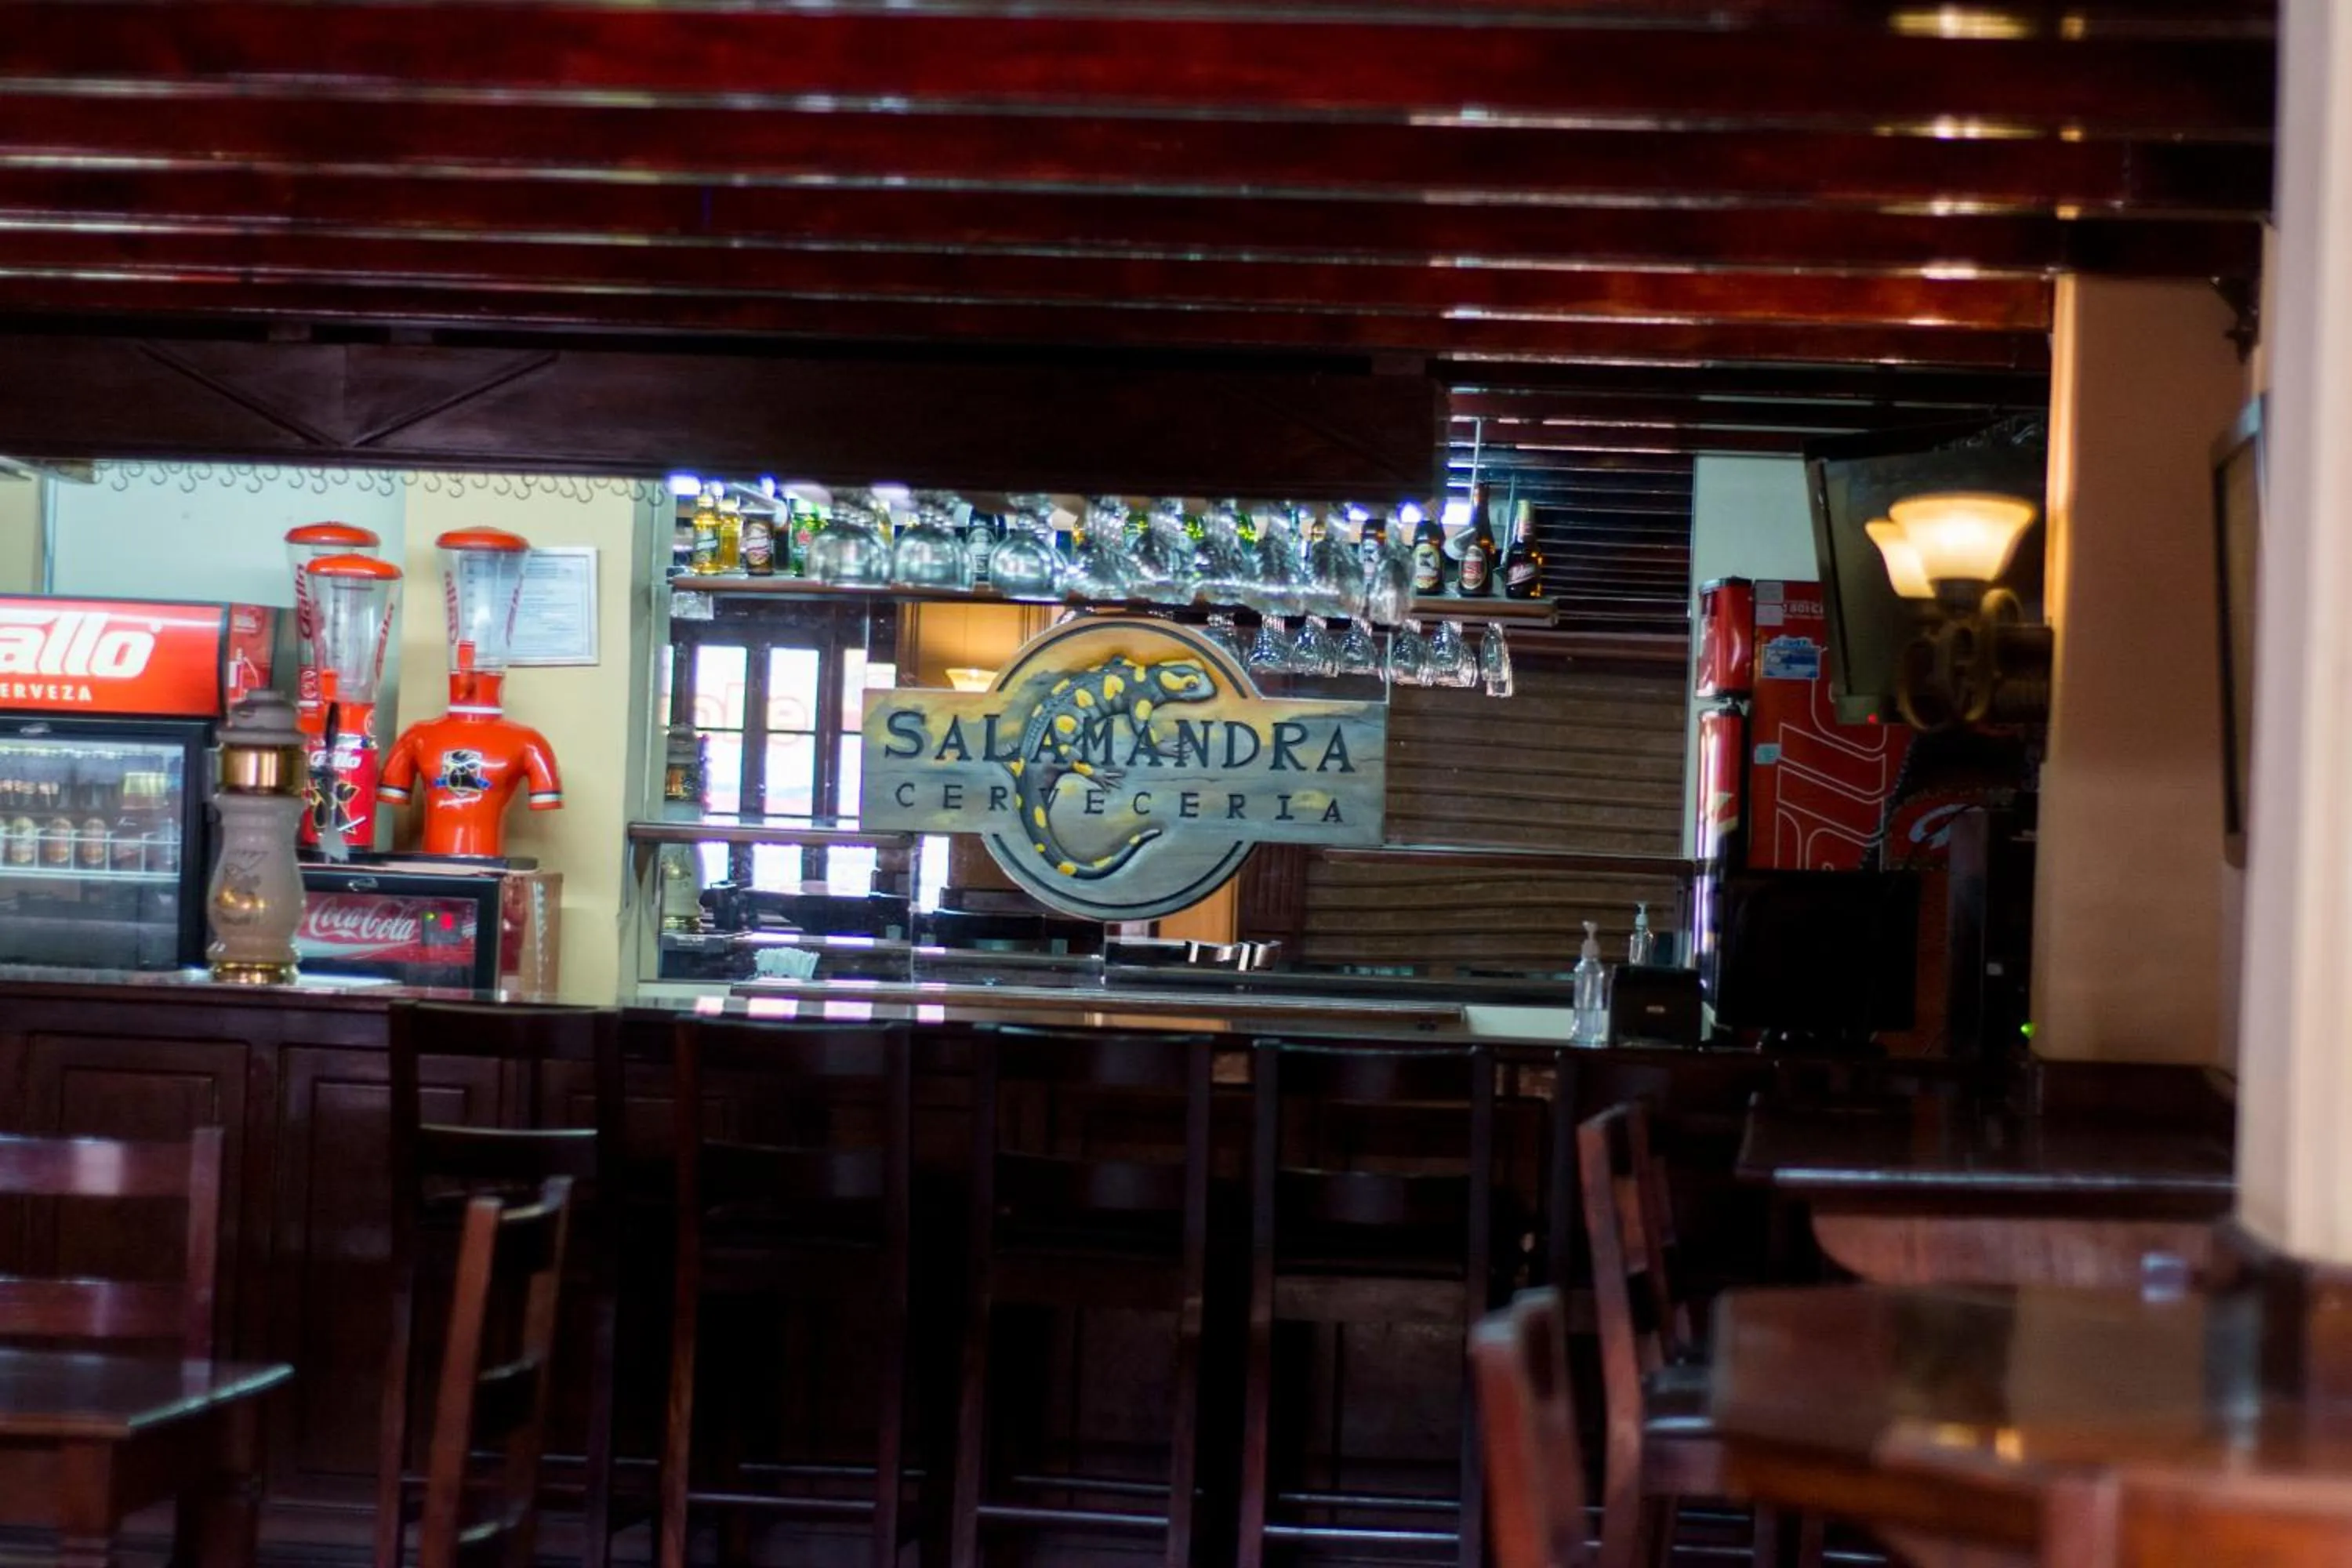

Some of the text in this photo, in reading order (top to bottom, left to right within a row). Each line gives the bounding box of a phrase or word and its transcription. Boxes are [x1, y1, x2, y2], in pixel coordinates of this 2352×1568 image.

[0, 607, 154, 680] allo
[0, 684, 93, 702] ERVEZA
[885, 710, 1355, 772] SALAMANDRA
[895, 783, 1344, 823] CERVECERIA
